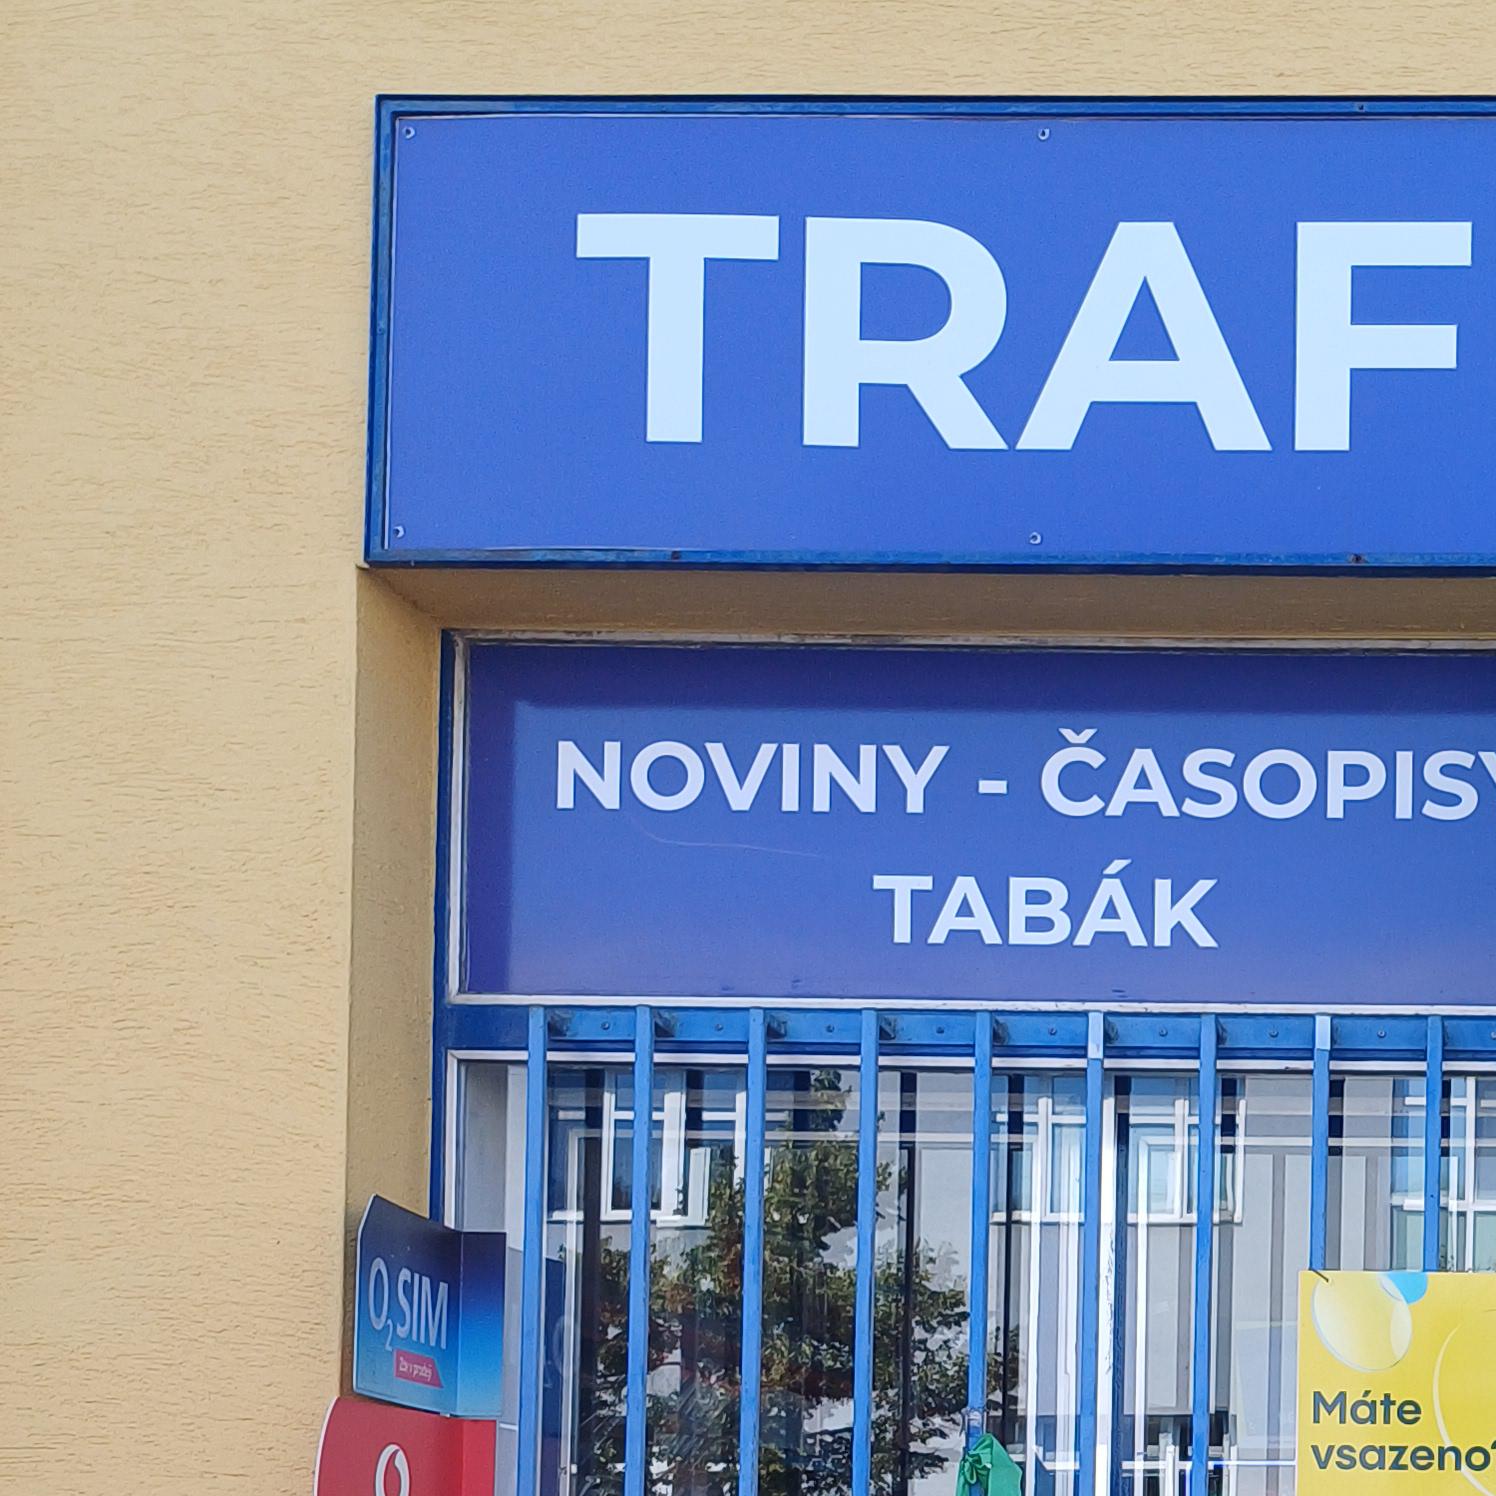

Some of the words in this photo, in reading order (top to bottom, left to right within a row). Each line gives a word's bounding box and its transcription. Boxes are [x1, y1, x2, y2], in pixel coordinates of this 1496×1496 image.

[554, 740, 950, 814] NOVINY
[978, 781, 1008, 795] -
[873, 858, 1219, 948] TABÁK
[397, 1267, 449, 1350] SIM
[1311, 1390, 1423, 1425] Máte
